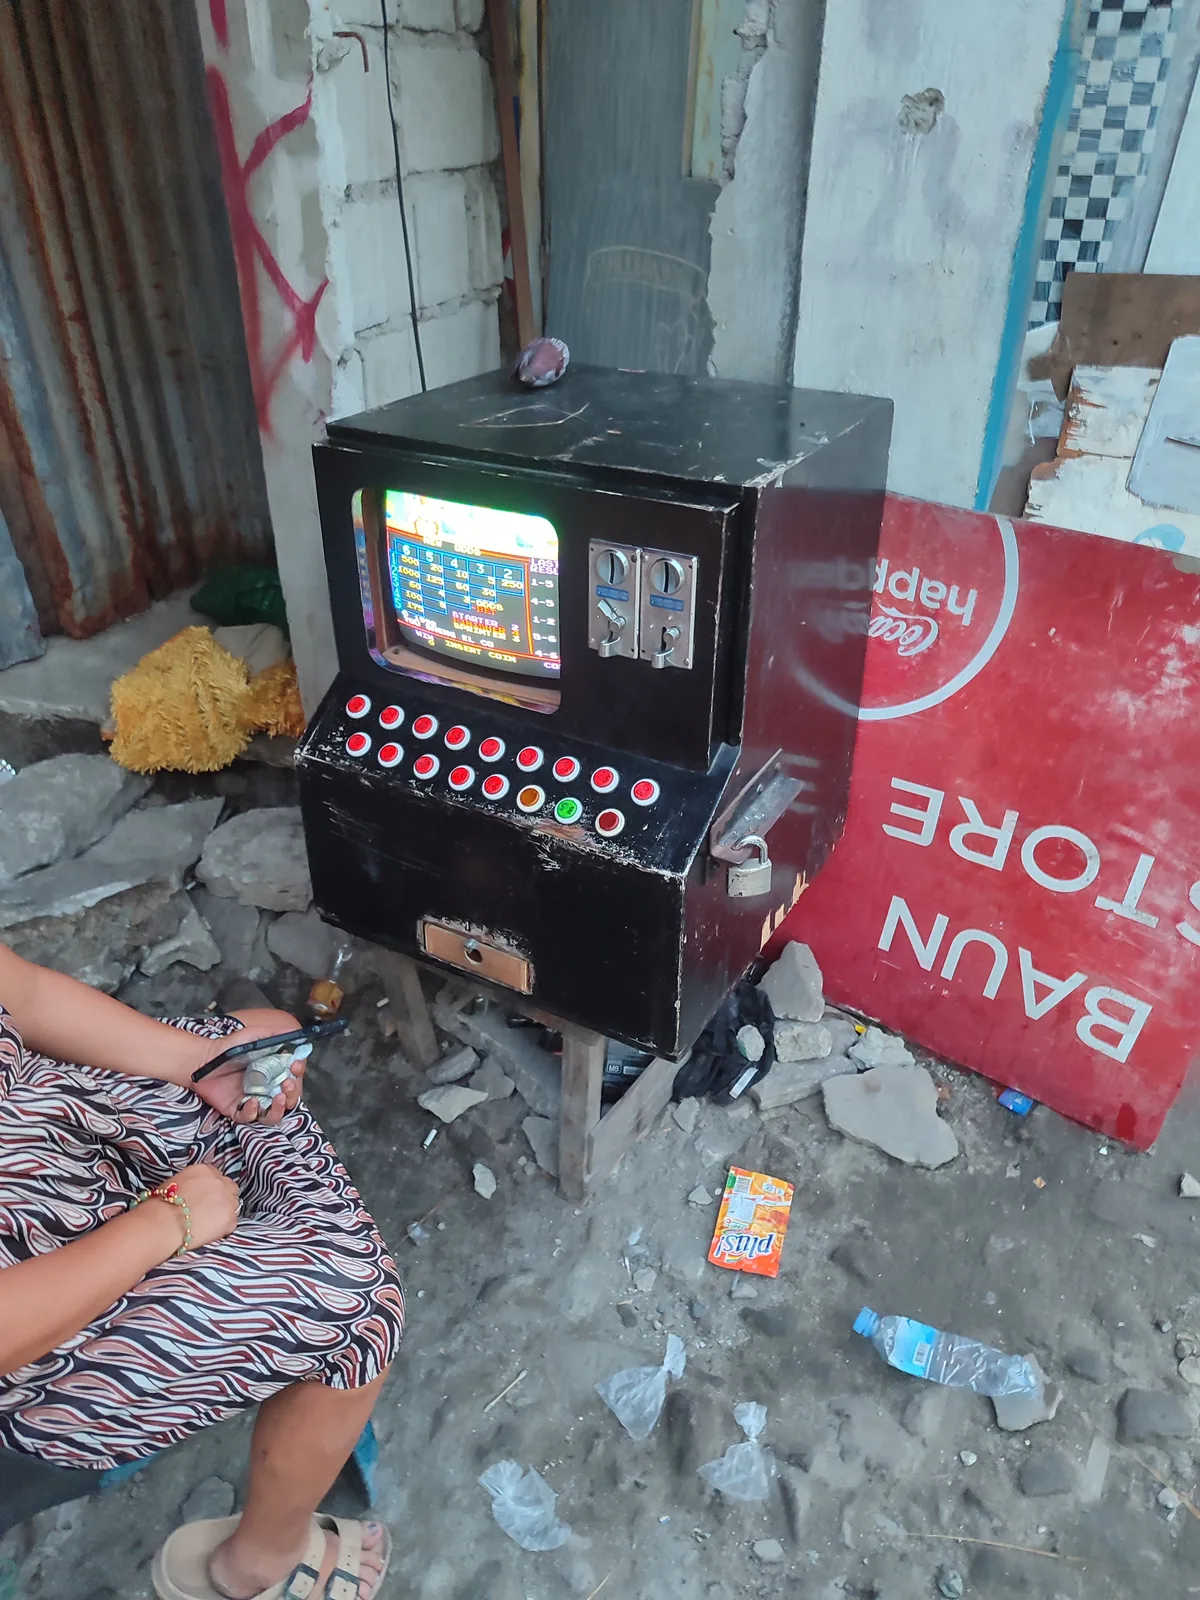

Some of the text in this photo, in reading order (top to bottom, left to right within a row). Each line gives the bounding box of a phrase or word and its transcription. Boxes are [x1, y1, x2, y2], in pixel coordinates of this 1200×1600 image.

[402, 544, 513, 579] 6 5 4 3 2
[398, 565, 420, 578] 1000
[401, 555, 419, 566] 500
[456, 570, 468, 579] 10
[501, 579, 523, 589] 250
[531, 578, 554, 588] 1-5
[405, 590, 422, 601] 100
[532, 616, 556, 625] 1-2
[415, 630, 434, 640] WIN
[445, 640, 482, 655] INSERT
[488, 651, 517, 663] COIN
[544, 662, 560, 670] CO
[877, 894, 1153, 1064] BAUN
[714, 1232, 775, 1258] plus!
